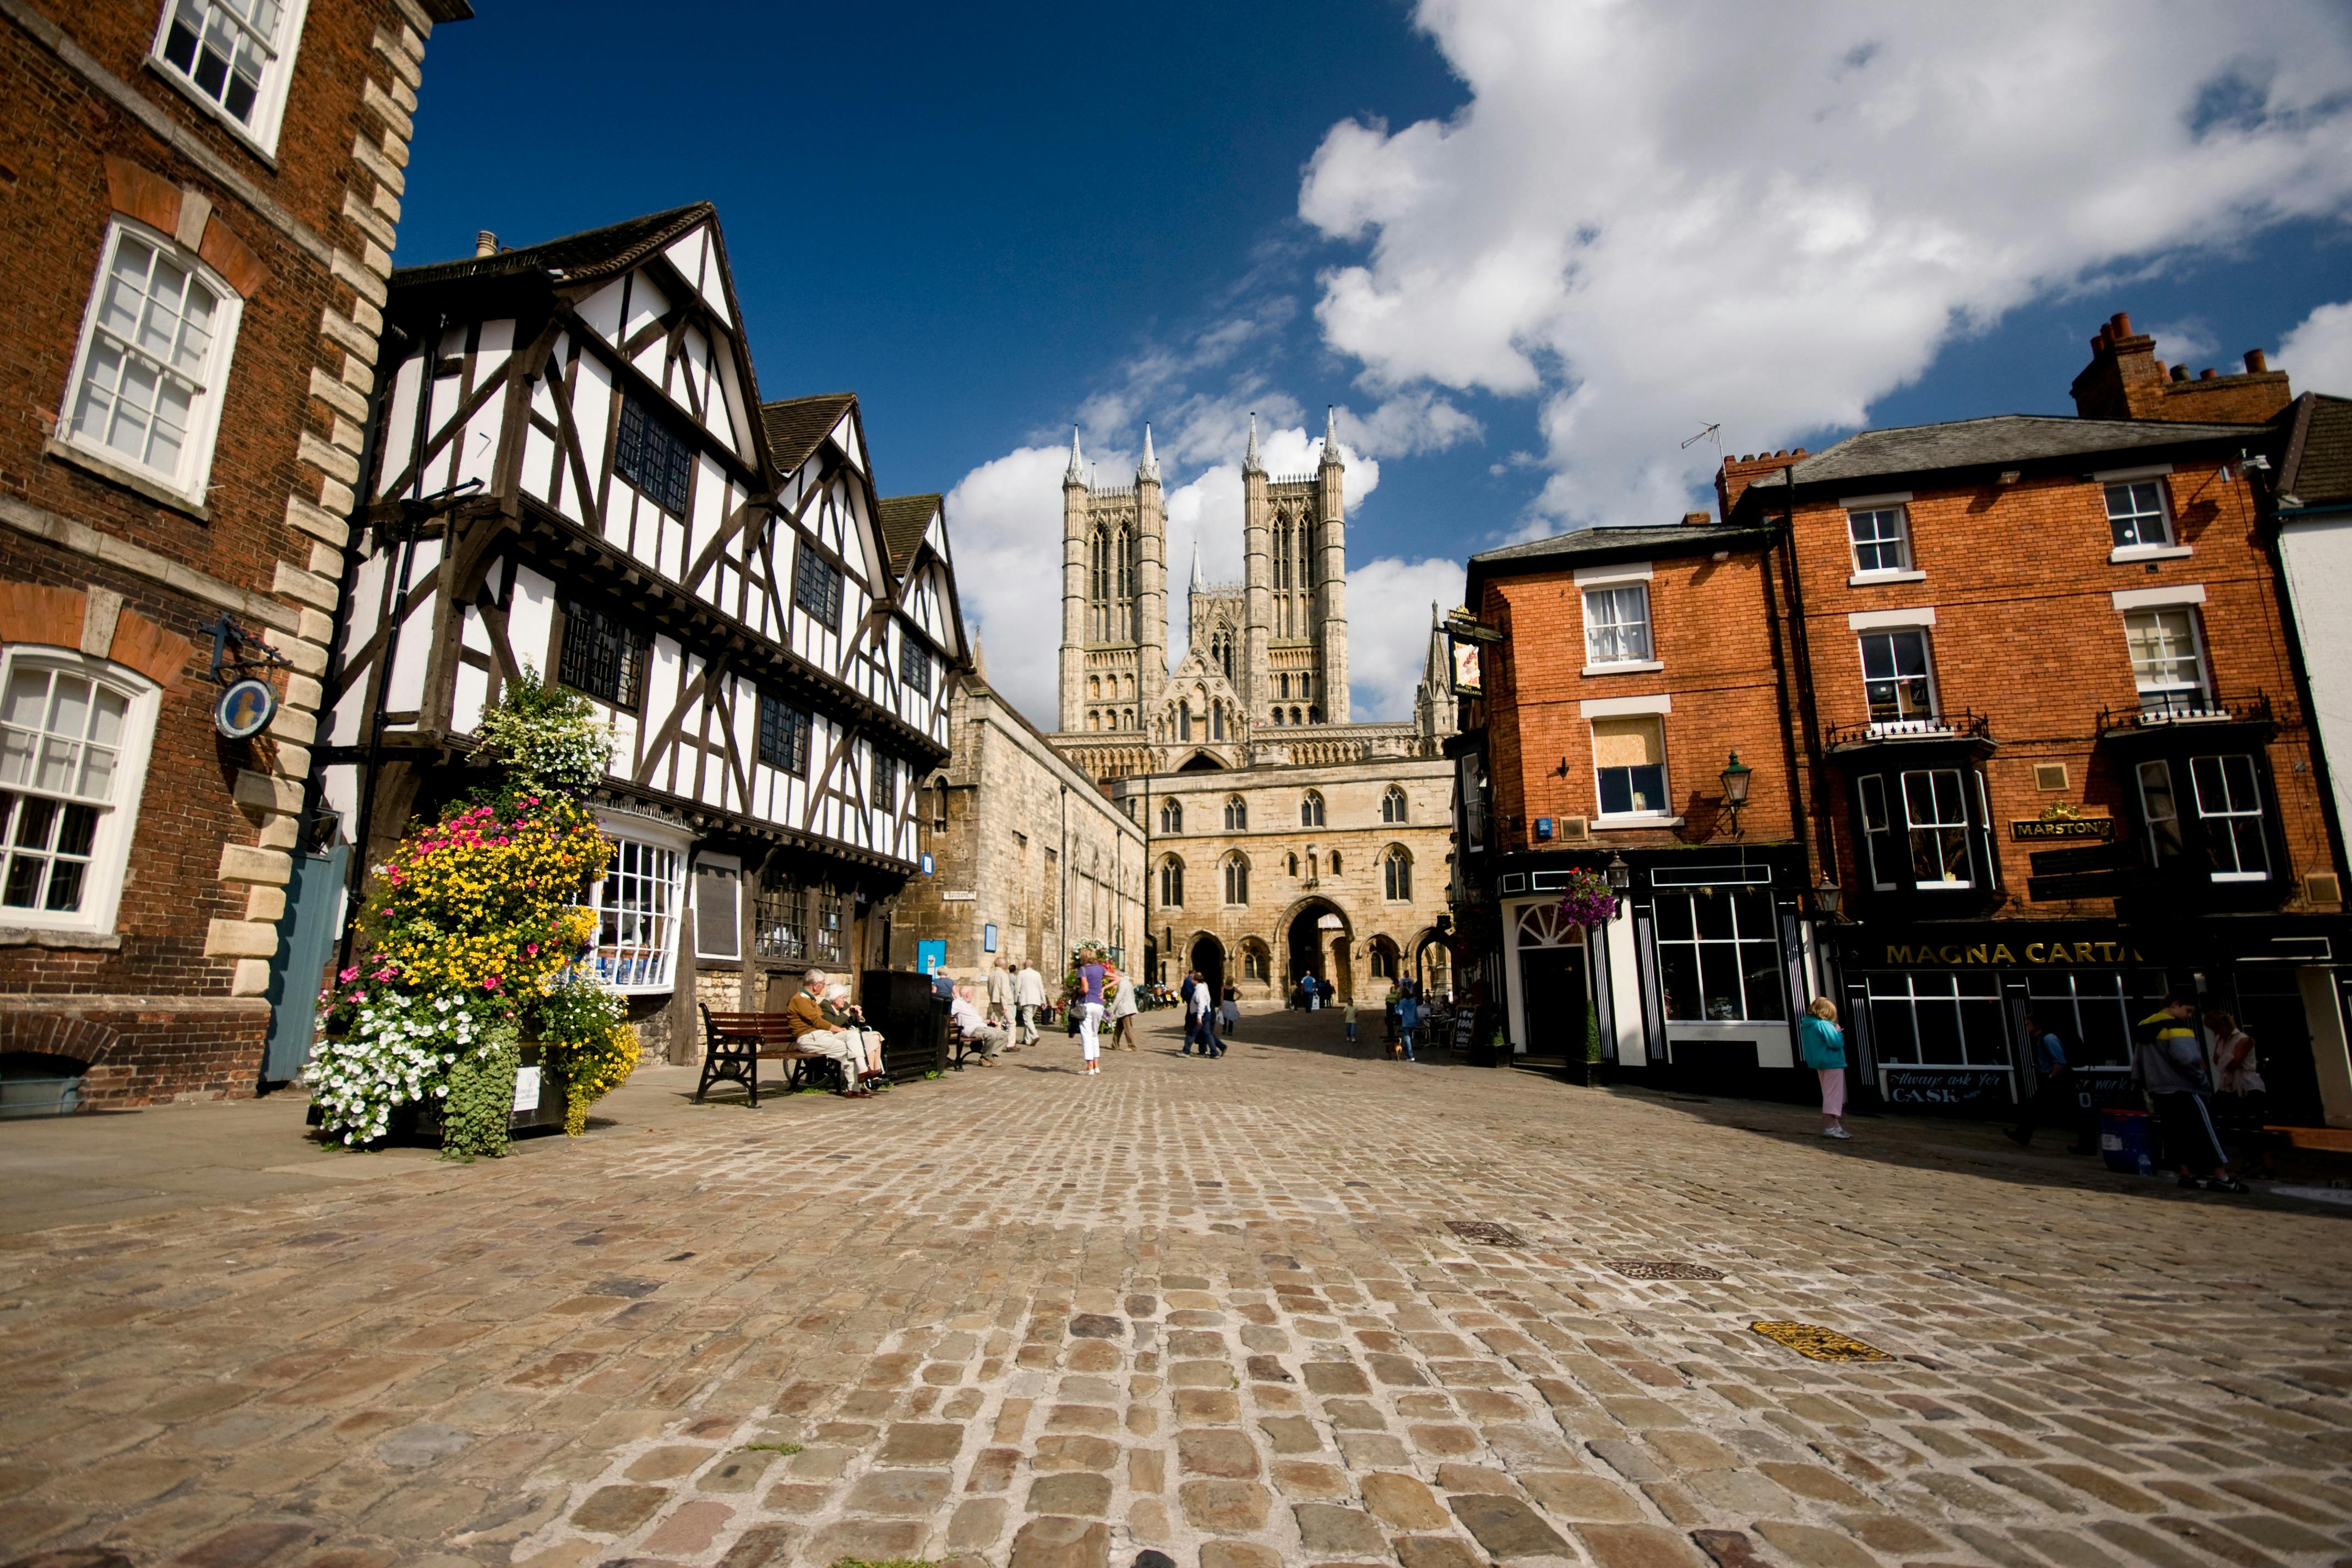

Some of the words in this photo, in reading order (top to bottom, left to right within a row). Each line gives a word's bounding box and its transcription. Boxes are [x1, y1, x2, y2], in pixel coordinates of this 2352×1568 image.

[2017, 822, 2110, 836] MARSTON
[1886, 943, 2017, 964] MAGNA
[1890, 1072, 1943, 1088] Always
[1947, 1072, 1972, 1086] ask
[1978, 1072, 2000, 1087] for
[2095, 1076, 2128, 1090] work
[1892, 1088, 1960, 1103] CASK
